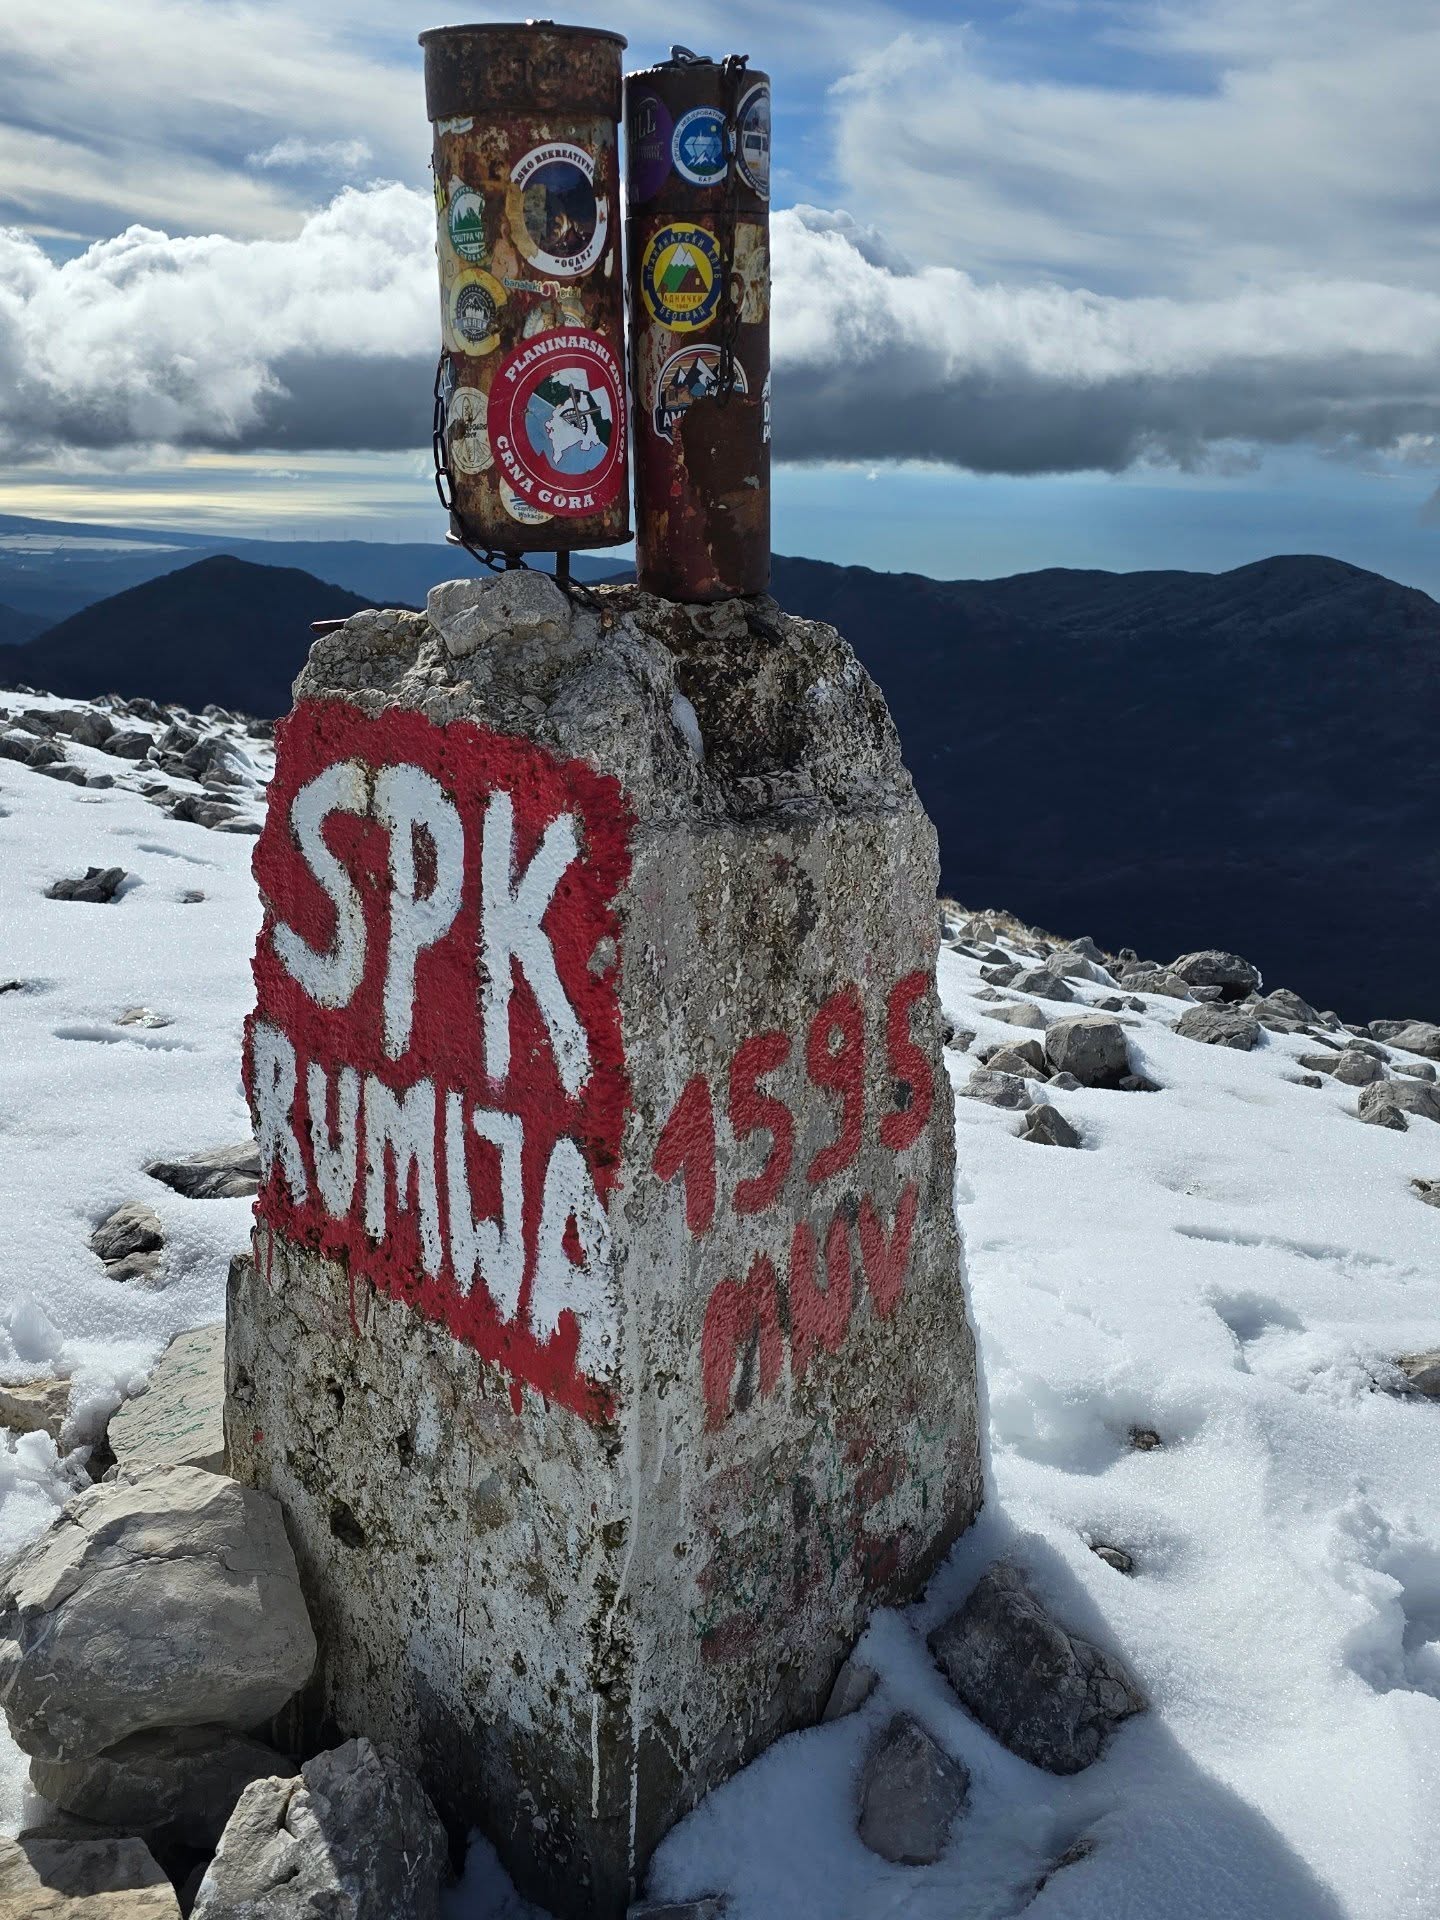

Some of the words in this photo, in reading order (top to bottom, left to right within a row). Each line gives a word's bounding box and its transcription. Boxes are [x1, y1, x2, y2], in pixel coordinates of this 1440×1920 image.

[535, 149, 593, 174] REKREATIVNI
[647, 232, 705, 280] ПЛАНИНАРСКИ
[707, 249, 722, 279] КЛУБ
[659, 304, 707, 321] БЕОГРАД
[663, 295, 703, 303] АДНИЧКИ
[504, 335, 611, 382] PLANINARSKI
[496, 435, 535, 493] CRNA
[537, 489, 595, 509] GORA
[273, 759, 593, 1099] SPK
[653, 970, 935, 1240] 1595
[251, 1024, 620, 1382] RUMIJA
